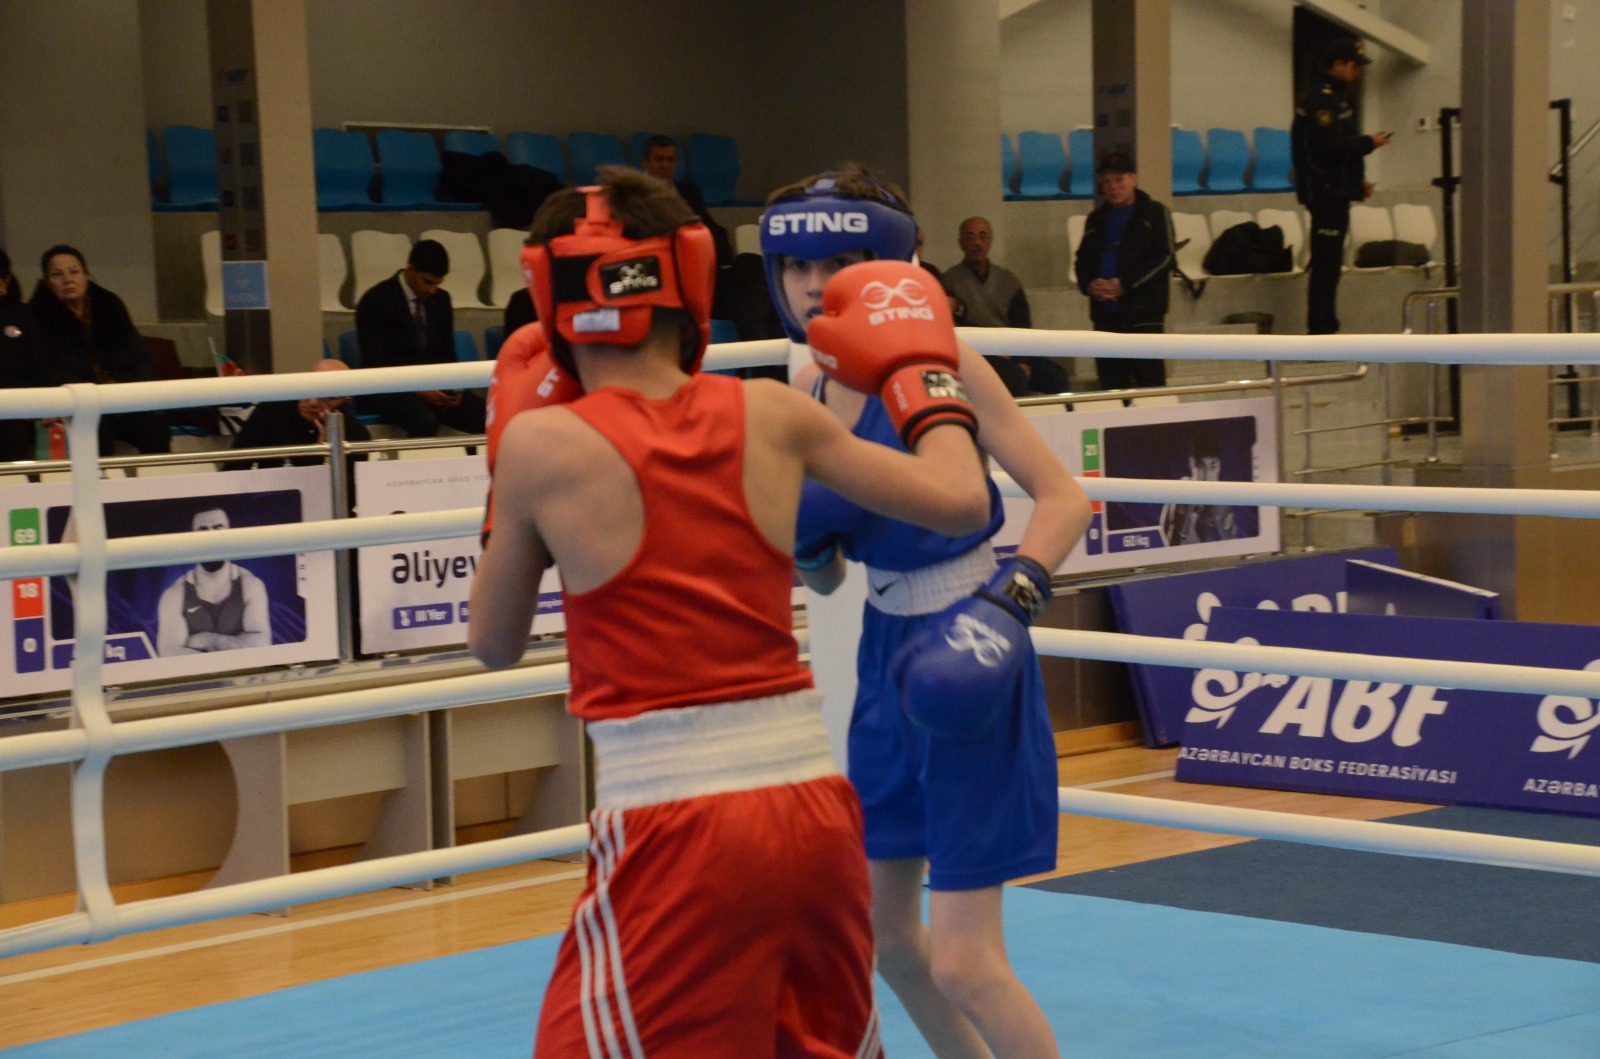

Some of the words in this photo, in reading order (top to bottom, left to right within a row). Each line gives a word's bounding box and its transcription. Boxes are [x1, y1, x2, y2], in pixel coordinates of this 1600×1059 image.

[769, 212, 868, 235] STING
[868, 305, 935, 325] STING
[536, 368, 559, 398] ST
[14, 528, 37, 544] 69
[1090, 528, 1098, 540] 0
[17, 582, 39, 598] 18
[23, 638, 37, 653] 0
[1258, 676, 1451, 748] ABF
[1178, 746, 1286, 769] AZƏRBAYCAN
[1289, 755, 1334, 773] BOKS
[1337, 761, 1457, 784] FEDERASİYASI
[1522, 778, 1600, 798] AZƏRBA
